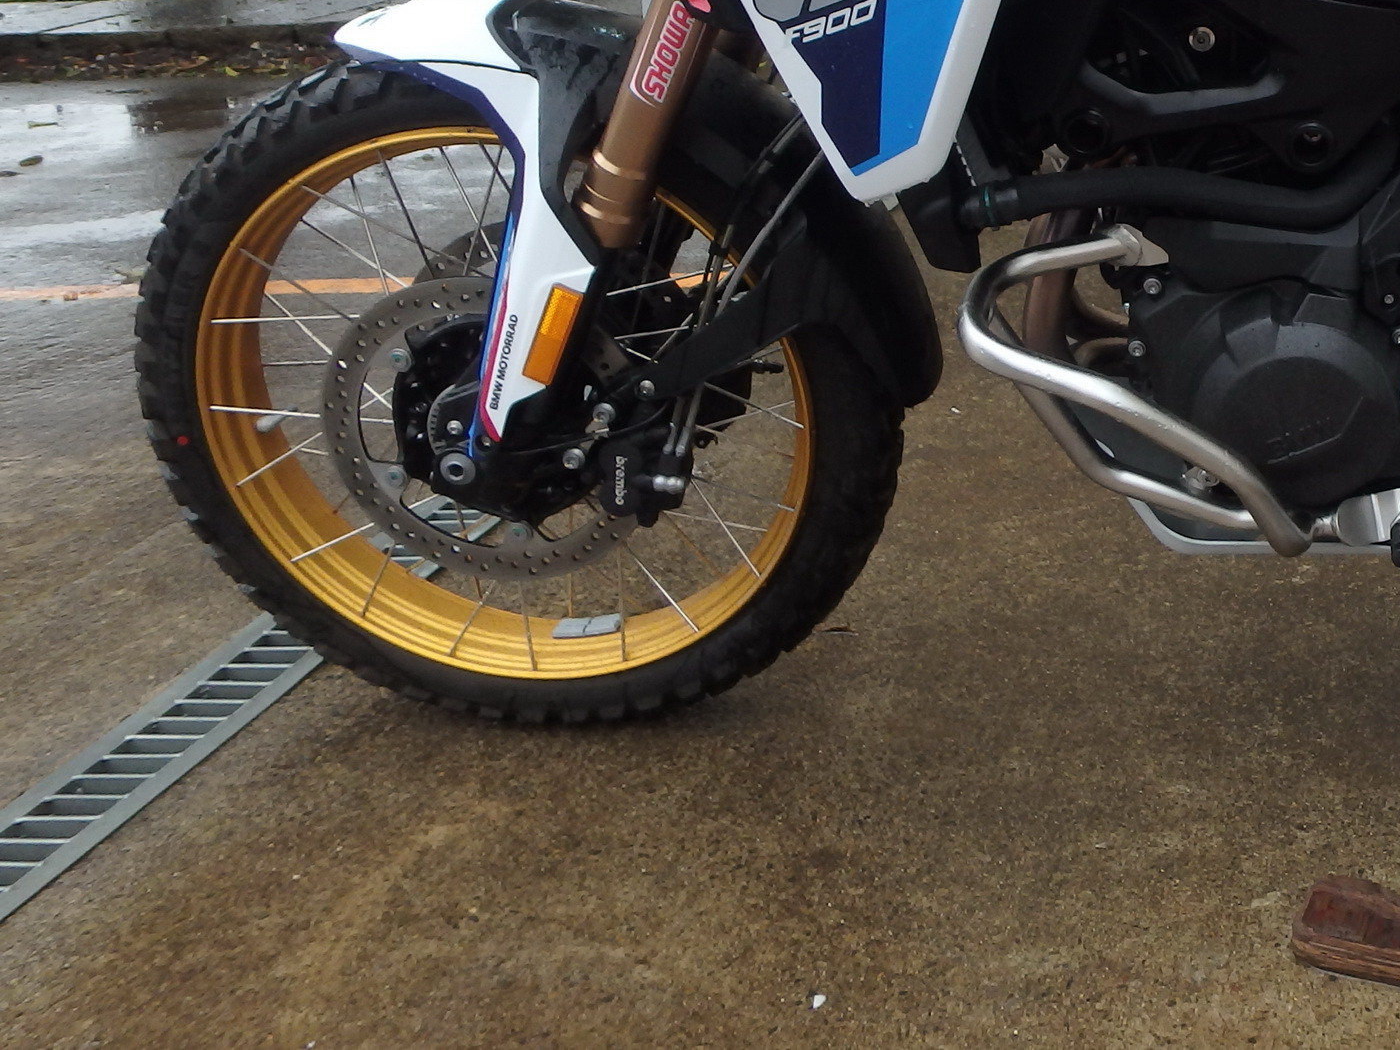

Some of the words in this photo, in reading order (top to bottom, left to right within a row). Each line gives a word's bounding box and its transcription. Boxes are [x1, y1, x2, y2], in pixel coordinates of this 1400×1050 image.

[642, 0, 695, 103] SHOWA
[489, 381, 503, 410] BMW
[496, 314, 518, 381] MOTORRAD
[615, 456, 628, 505] brembo
